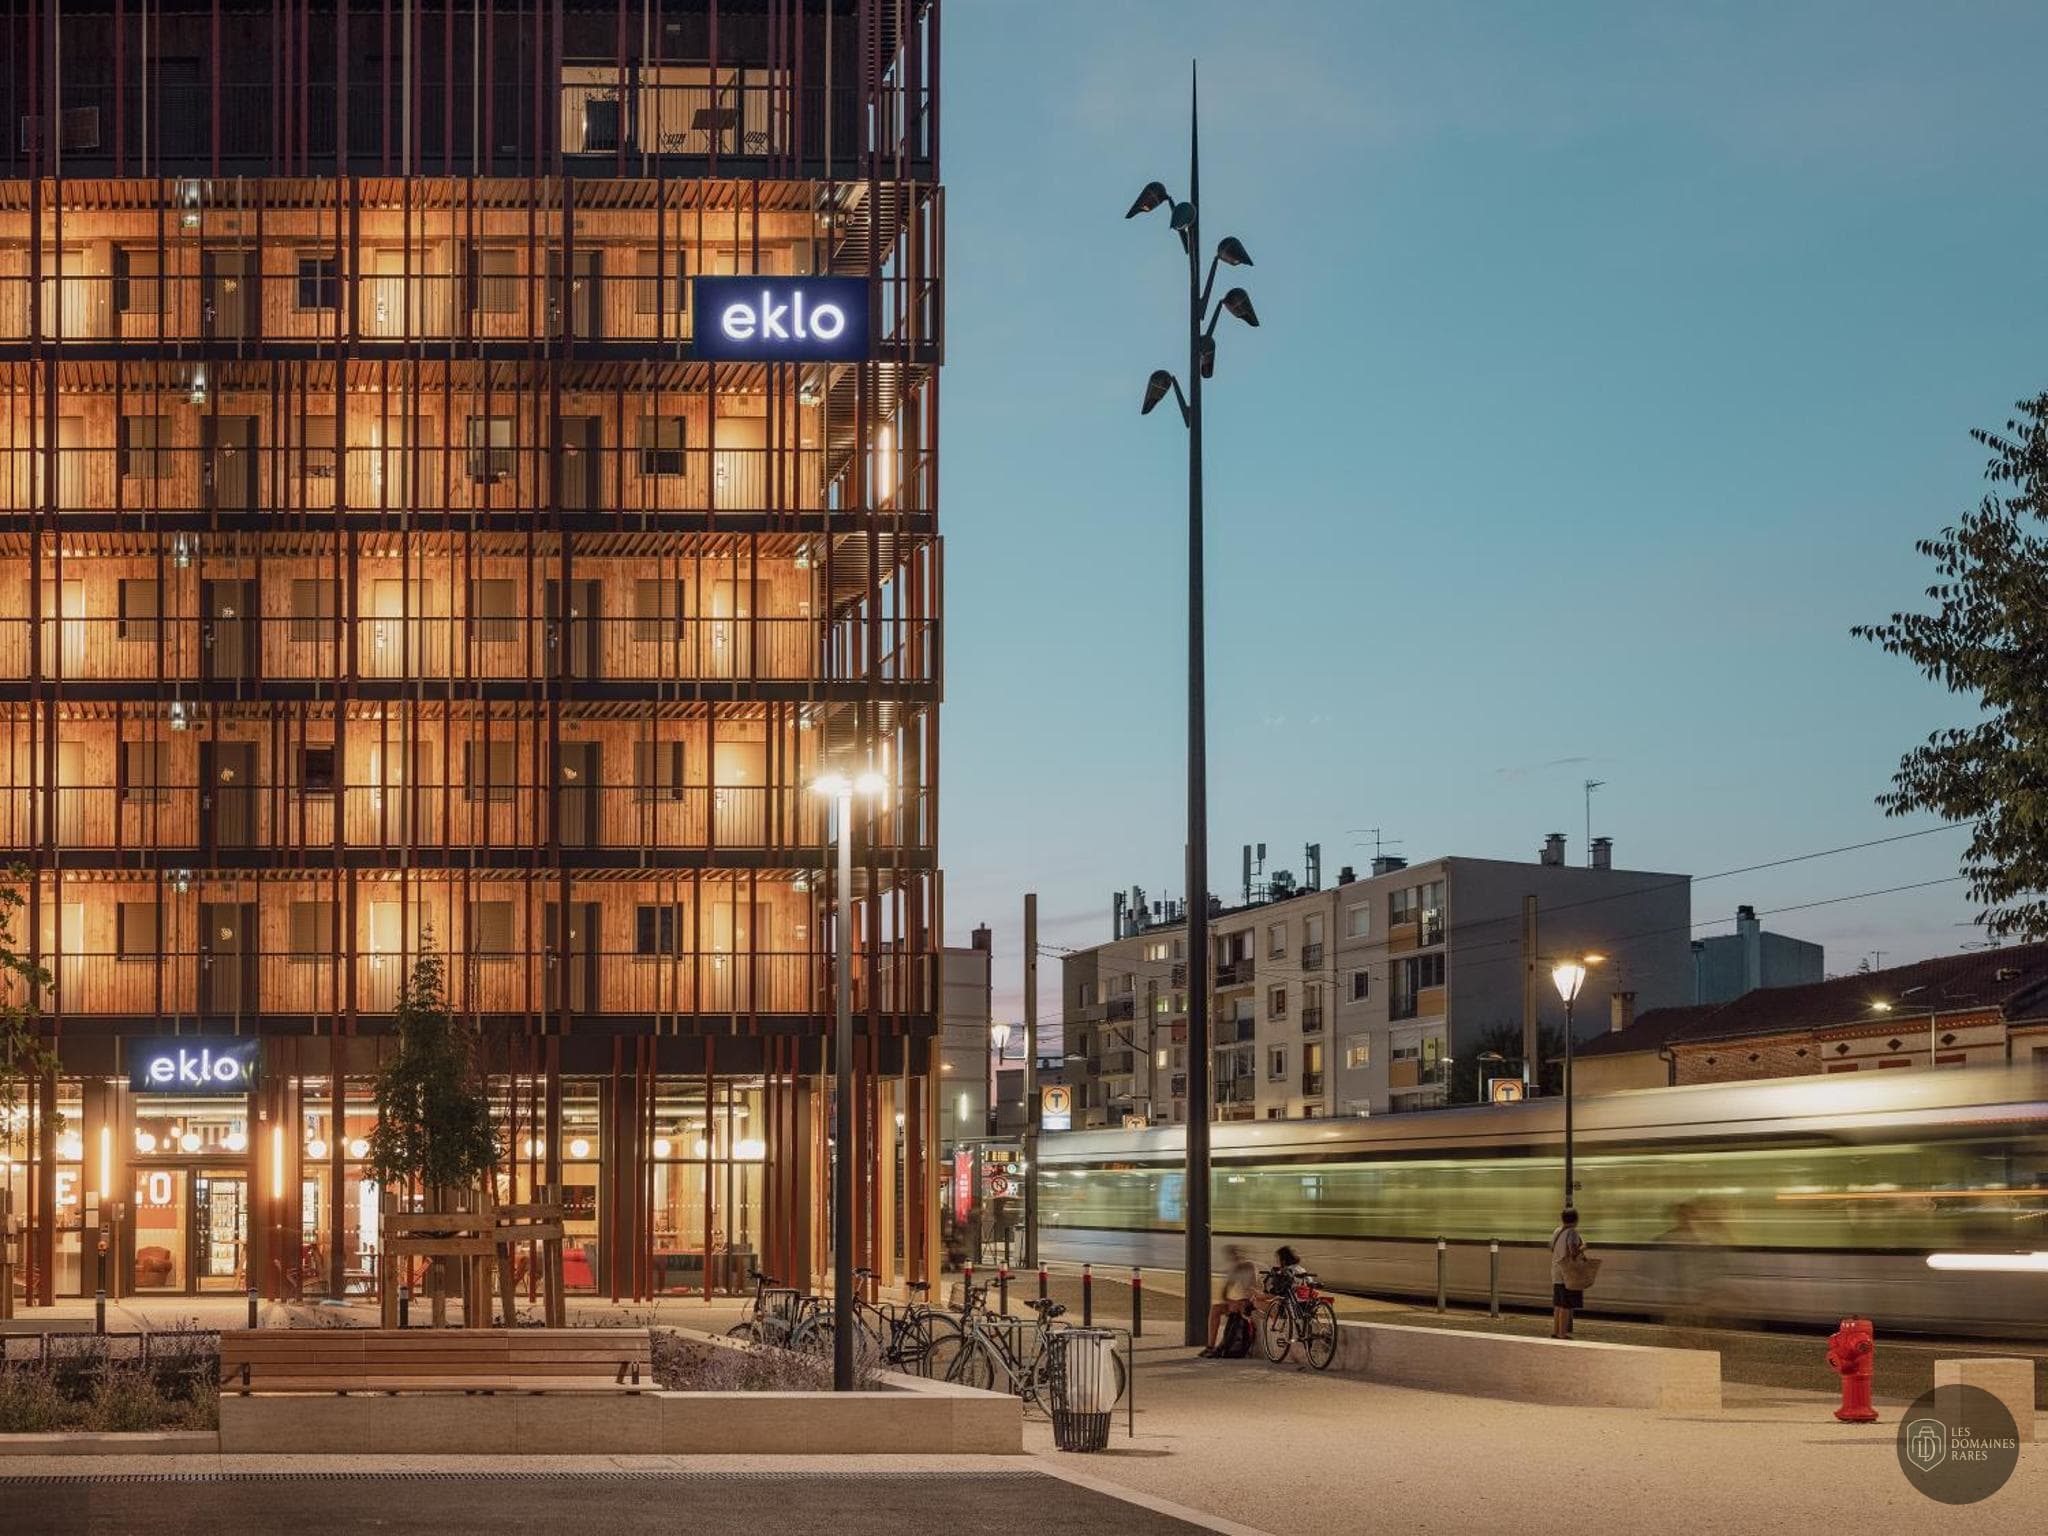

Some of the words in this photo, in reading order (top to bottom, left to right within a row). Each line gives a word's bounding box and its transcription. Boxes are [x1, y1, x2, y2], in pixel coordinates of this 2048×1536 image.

[722, 290, 845, 340] eklo
[149, 1048, 239, 1082] eklo
[1051, 1093, 1063, 1109] T
[1502, 1087, 1514, 1101] T
